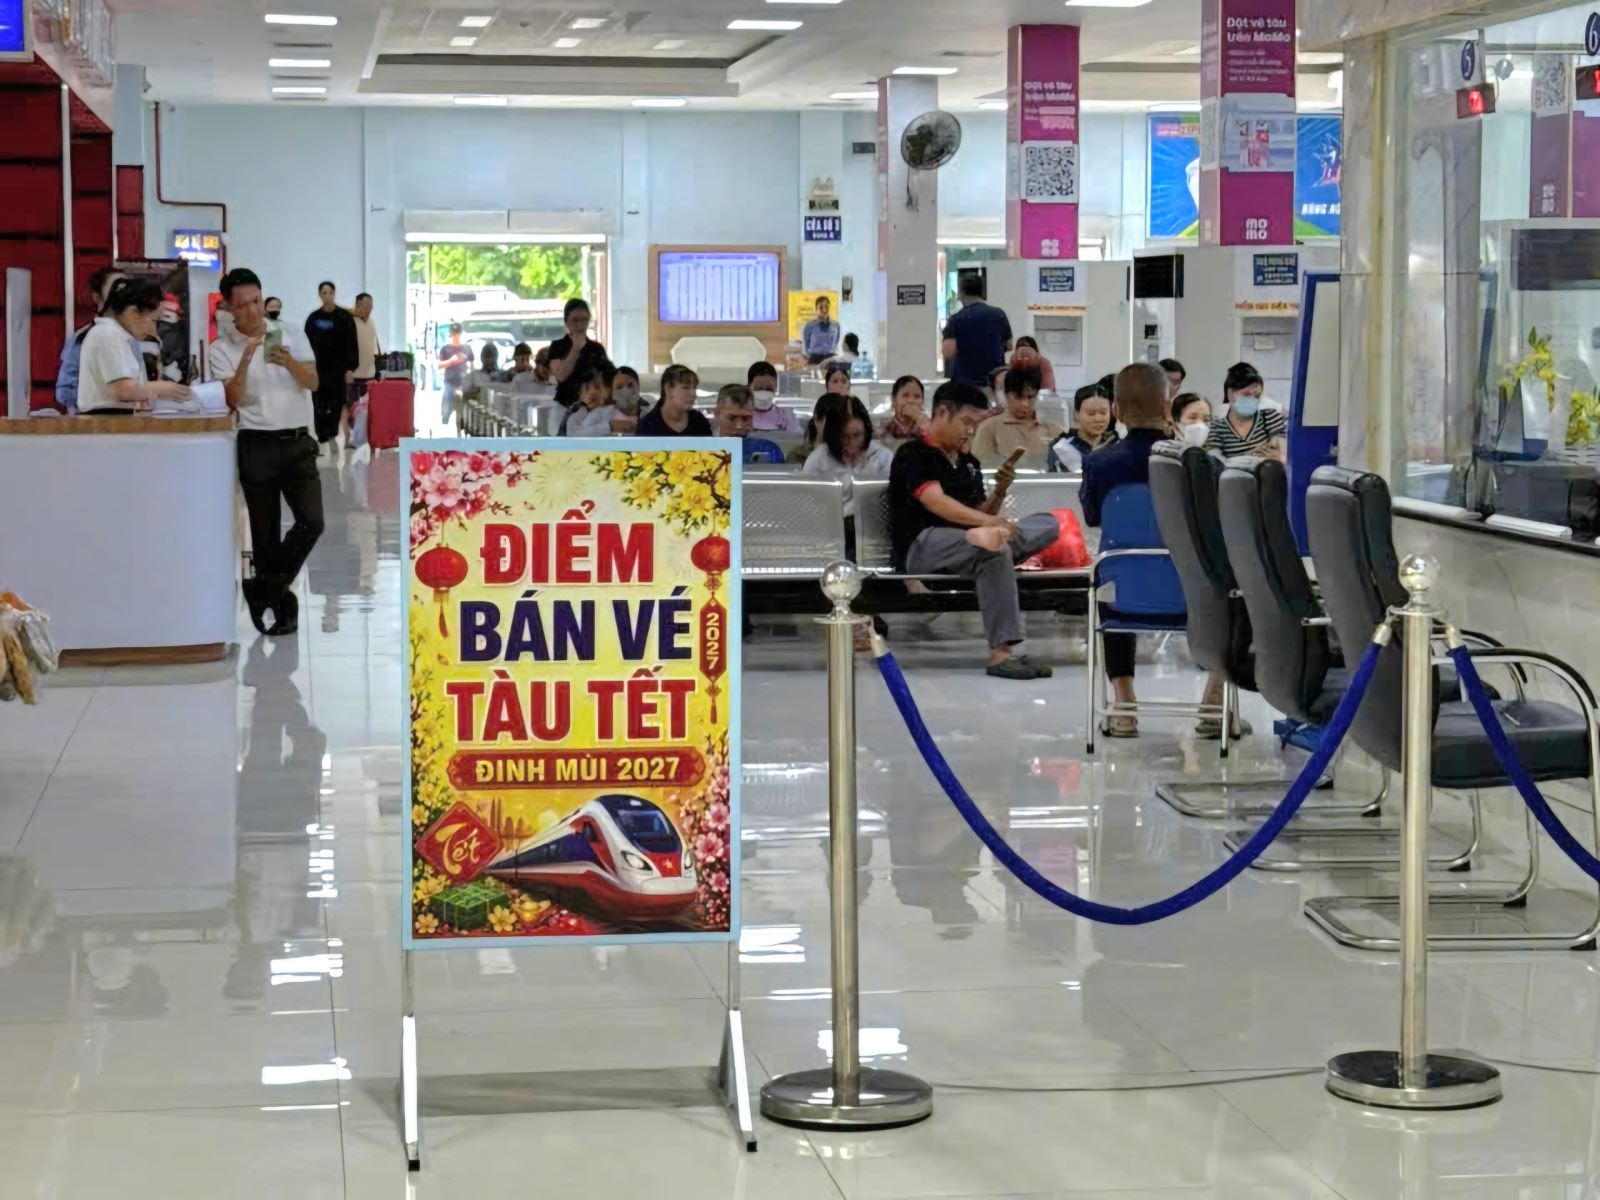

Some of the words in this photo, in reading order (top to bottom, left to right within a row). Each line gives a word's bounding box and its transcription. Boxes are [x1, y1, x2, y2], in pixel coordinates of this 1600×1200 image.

[1588, 15, 1599, 53] 6
[480, 500, 654, 584] ĐIỂM
[459, 589, 596, 663] BÁN
[612, 585, 692, 662] VÉ
[705, 613, 720, 670] 2027
[446, 670, 571, 742] TÀU
[587, 665, 696, 740] TẾT
[475, 759, 545, 782] ĐINH
[556, 753, 607, 781] MÙI
[616, 757, 680, 780] 2027
[435, 822, 481, 875] Tết
